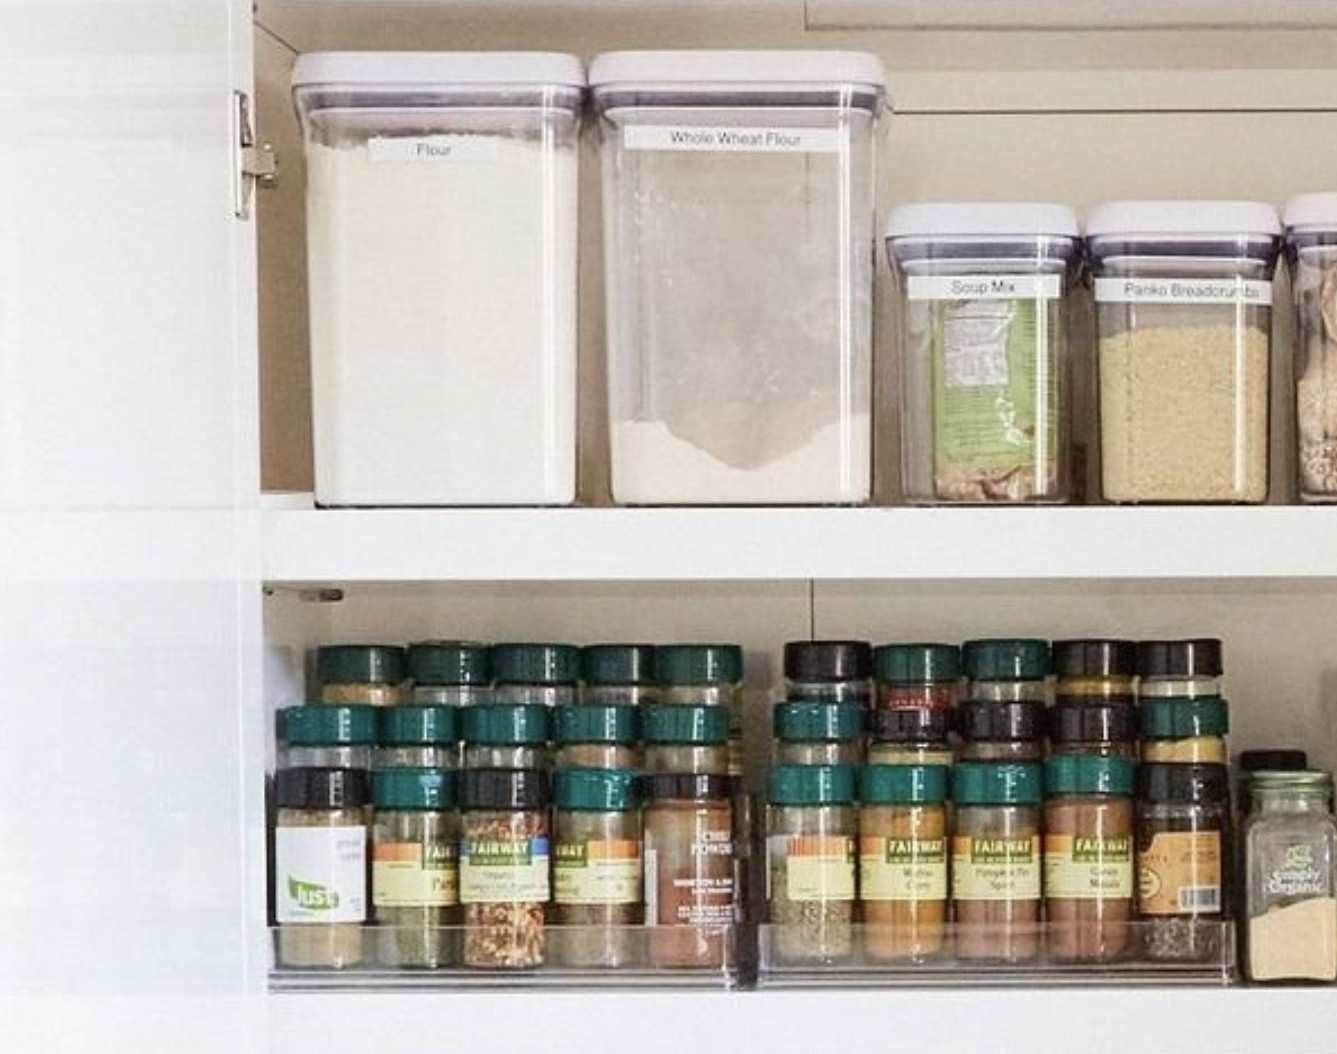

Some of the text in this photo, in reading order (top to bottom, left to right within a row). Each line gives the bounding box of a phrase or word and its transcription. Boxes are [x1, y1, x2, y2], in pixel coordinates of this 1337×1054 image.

[670, 130, 801, 146] Whole Wheat Flour
[416, 143, 452, 157] Flour
[951, 279, 1016, 296] Soup Mix
[1124, 282, 1167, 297] Panko
[471, 841, 529, 855] FAIRWAY
[975, 840, 1031, 853] FAIRWAY
